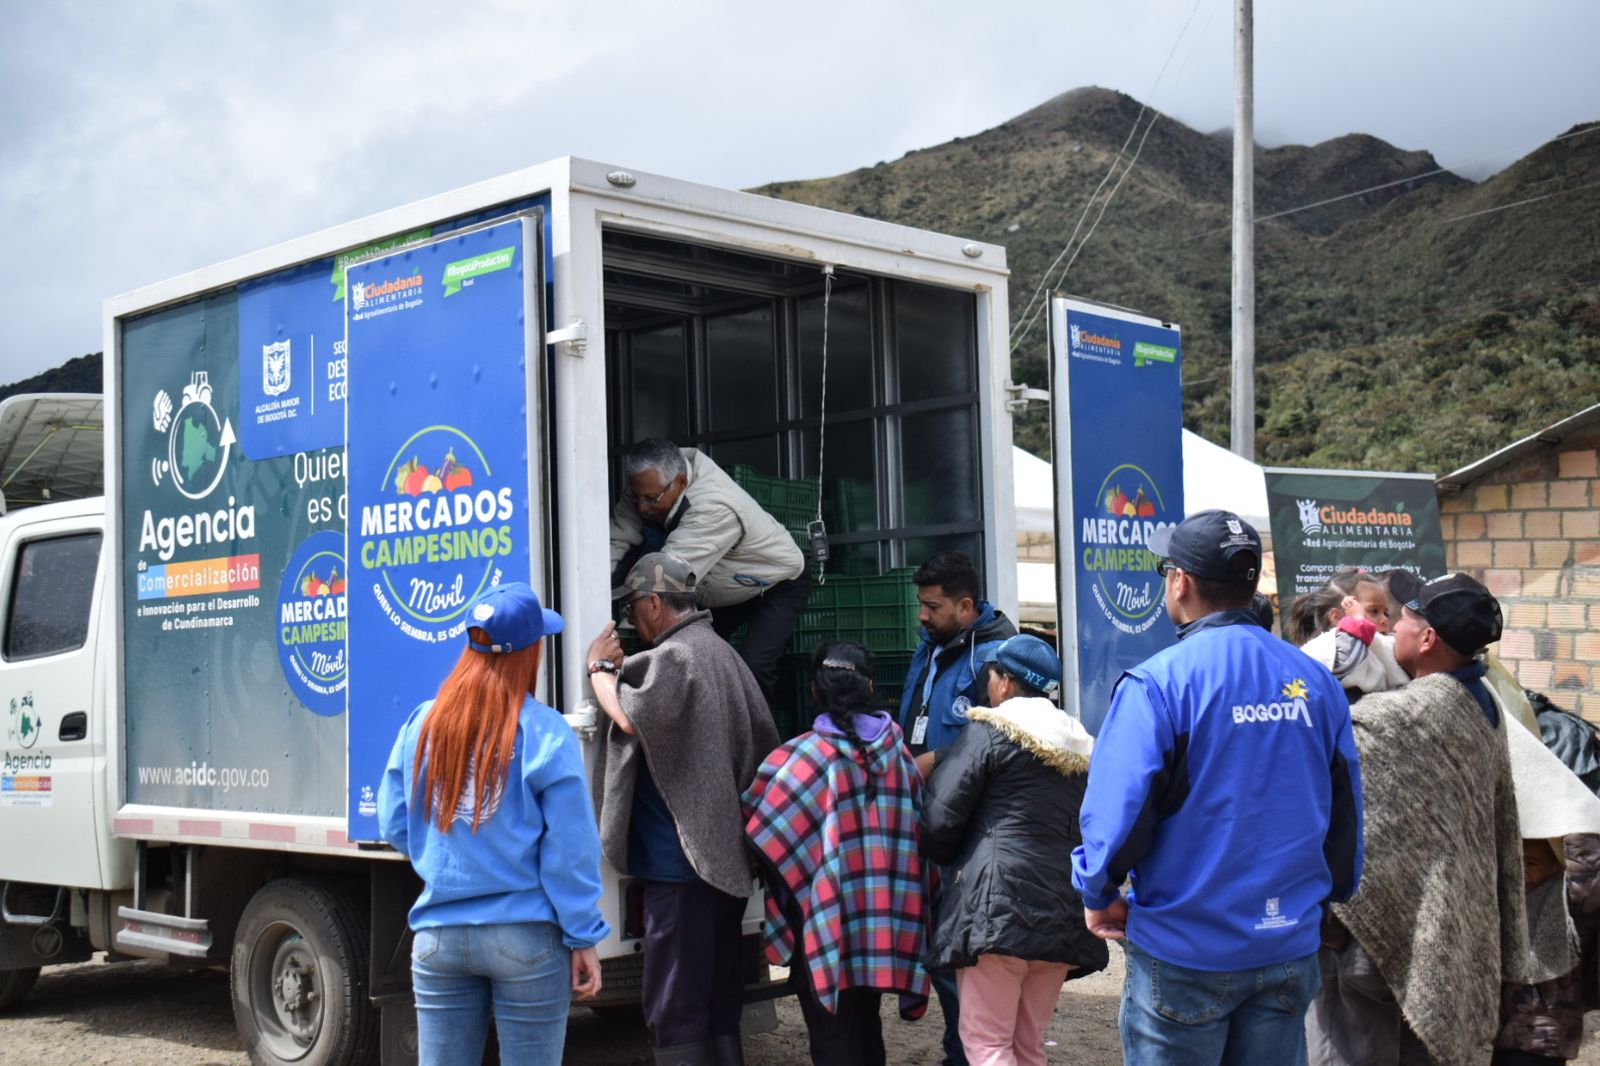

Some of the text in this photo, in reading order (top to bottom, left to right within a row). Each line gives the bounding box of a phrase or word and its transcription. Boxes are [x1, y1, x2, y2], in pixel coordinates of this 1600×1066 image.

[365, 286, 423, 307] ALIMENTARIA
[308, 496, 332, 524] es
[361, 487, 514, 537] MERCADOS
[139, 495, 255, 561] Agencia
[1082, 517, 1176, 545] MERCAD
[1322, 524, 1413, 536] ALIMENTARIA
[361, 525, 513, 569] CAMPESINOS
[1379, 540, 1387, 548] de
[138, 559, 147, 571] de
[1083, 546, 1160, 572] CAMPESIN
[1300, 563, 1334, 575] Compra
[139, 563, 259, 592] Comercialización
[186, 600, 206, 614] para
[207, 599, 216, 611] el
[217, 595, 260, 610] Desarrollo
[408, 573, 465, 614] Móvil
[1117, 582, 1151, 611] Móvil
[162, 615, 234, 630] de Cundinamarca
[281, 596, 346, 624] MERCAD
[373, 583, 392, 616] QUIEN
[390, 611, 401, 626] LO
[437, 630, 447, 642] ES
[448, 620, 466, 639] QUIE
[312, 649, 345, 676] Móvil
[1024, 669, 1045, 687] NY
[4, 750, 52, 775] Agencia
[138, 760, 269, 792] www.acidc.gov.co
